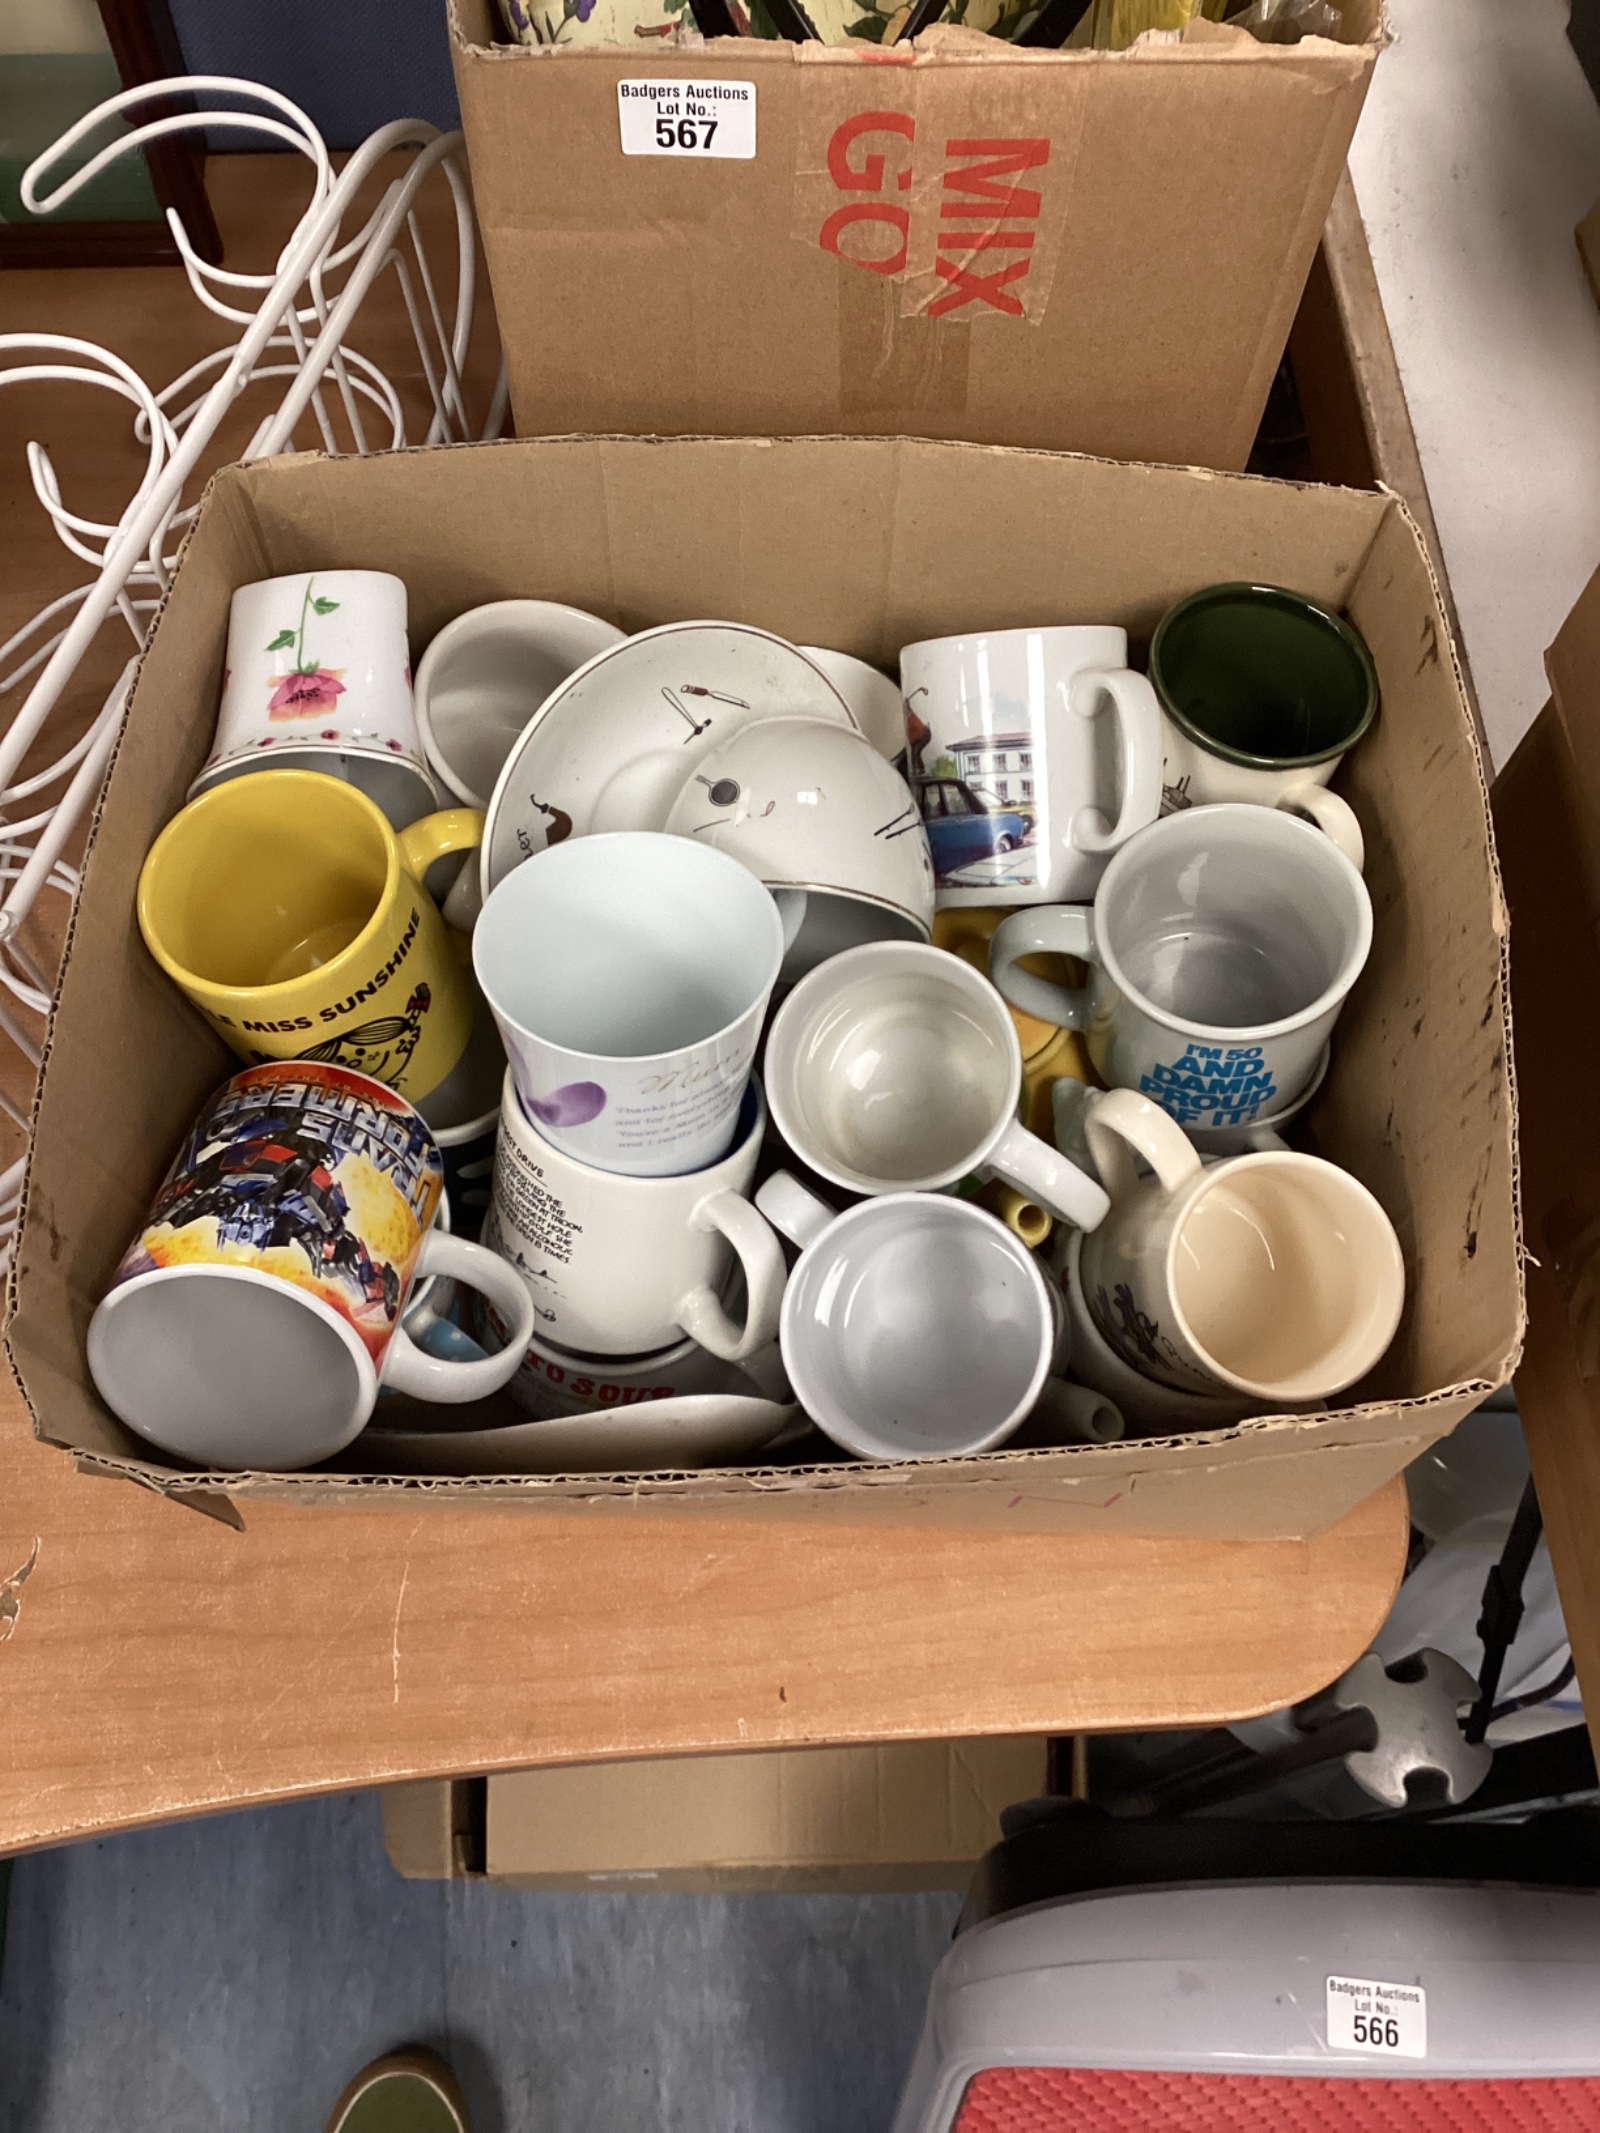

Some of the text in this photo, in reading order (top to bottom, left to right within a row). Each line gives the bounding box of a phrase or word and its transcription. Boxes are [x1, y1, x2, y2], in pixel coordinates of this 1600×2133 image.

[621, 84, 748, 100] Badgers Auctions
[657, 102, 680, 115] Lot
[656, 118, 718, 149] 567
[928, 138, 1051, 317] MIX
[242, 907, 420, 1032] MISS SUNSHINE
[1171, 1055, 1265, 1078] AND
[1186, 1043, 1263, 1060] I'M 50
[1139, 1074, 1277, 1110] PROUD
[1152, 1062, 1273, 1095] DAMN
[1212, 1104, 1261, 1126] IT!
[214, 1083, 429, 1181] FORMERS
[296, 1111, 429, 1226] TRANS
[516, 1148, 545, 1178] DRIVE
[1329, 1980, 1420, 2003] Badgers Auctions
[1355, 1999, 1371, 2013] Lot
[1354, 2015, 1399, 2047] 566
